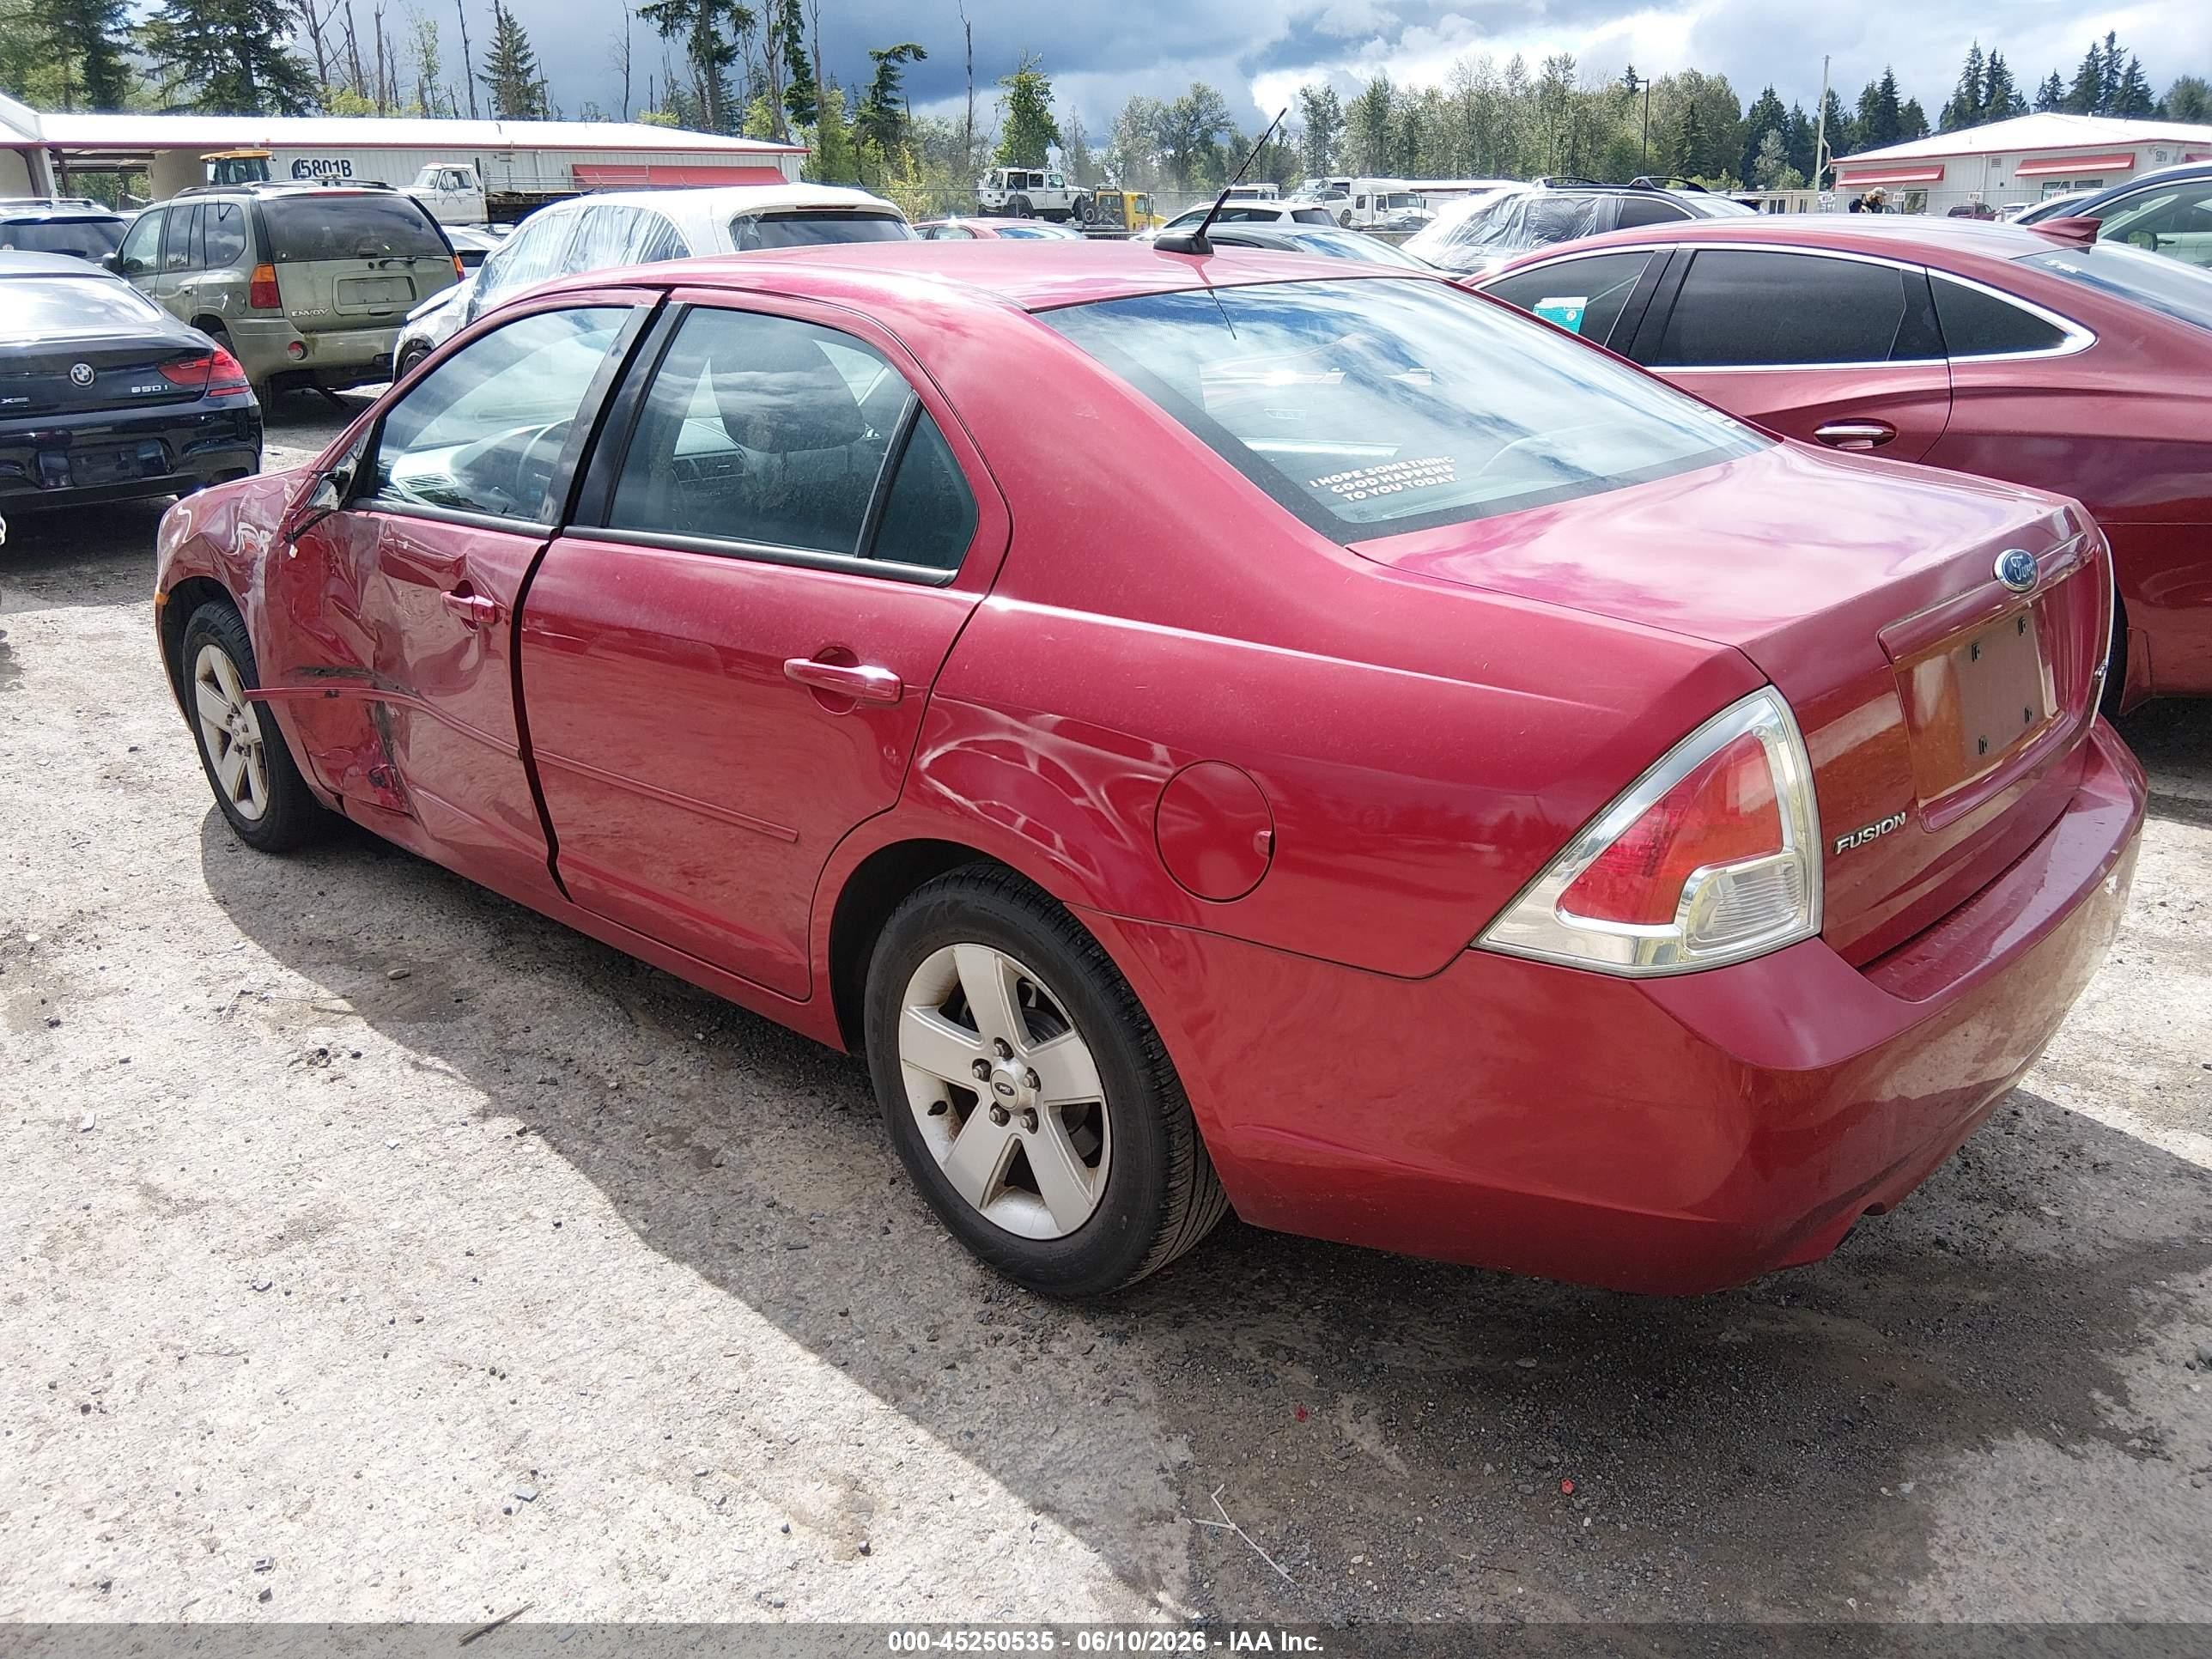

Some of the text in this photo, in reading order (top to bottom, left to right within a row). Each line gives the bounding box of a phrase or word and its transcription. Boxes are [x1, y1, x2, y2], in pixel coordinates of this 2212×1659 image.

[1317, 470, 1365, 487] HOPE
[1364, 456, 1455, 476] SOMETHING
[1331, 465, 1455, 494] GOOD HAPPENS
[1342, 474, 1461, 501] TO YOU TODAY.
[2010, 555, 2034, 580] Ford
[1833, 811, 1906, 855] FUSION
